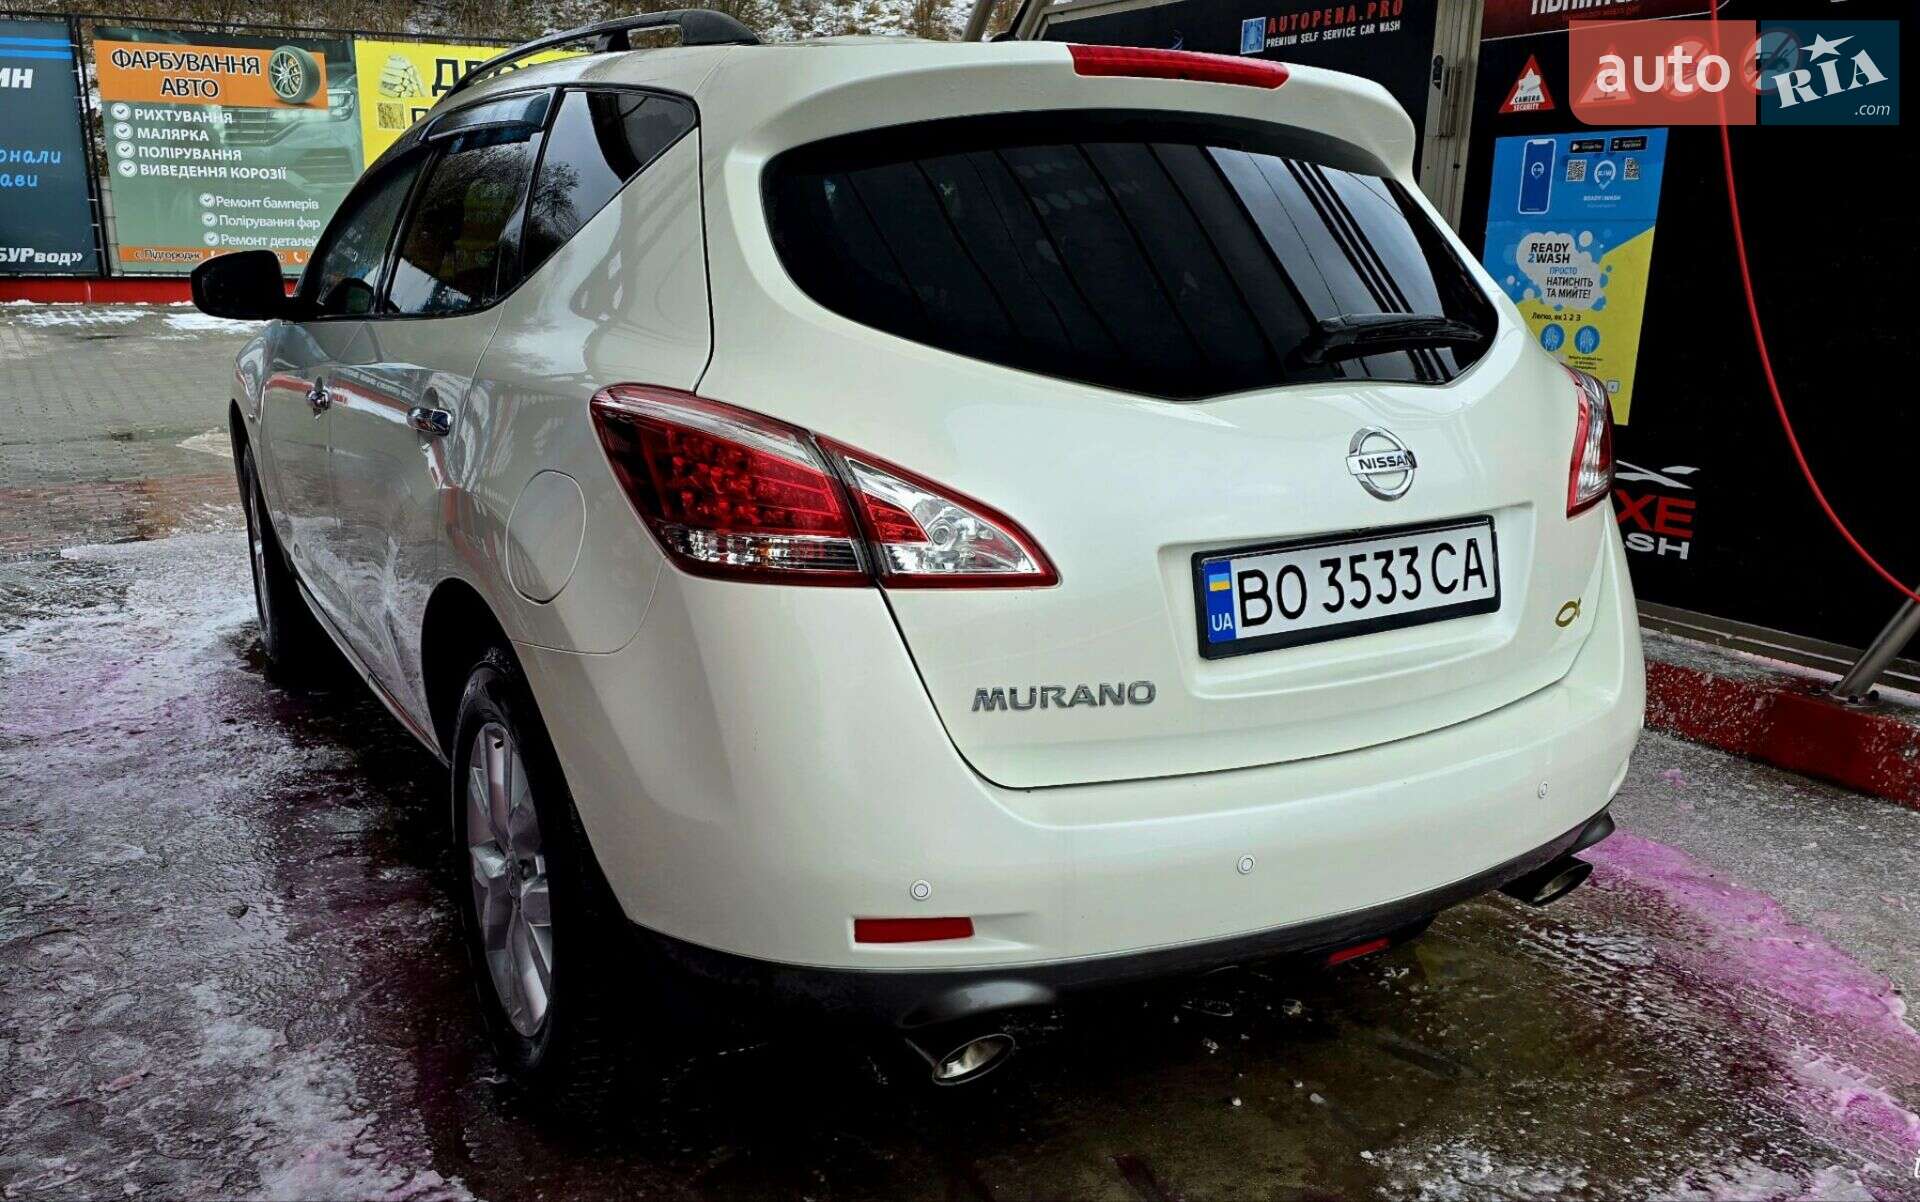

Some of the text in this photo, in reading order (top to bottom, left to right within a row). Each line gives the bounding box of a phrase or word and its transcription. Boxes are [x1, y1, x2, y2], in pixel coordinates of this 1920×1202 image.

[1268, 0, 1403, 34] AUTOPENA.PRO
[1266, 20, 1401, 48] PREMIUM SELF SERVICE CAR WASH
[111, 48, 262, 76] ФАРБУВАННЯ
[160, 77, 220, 99] АВТО
[134, 108, 233, 126] РИХТУВАННЯ
[137, 127, 210, 142] МАЛЯРКА
[138, 146, 242, 161] ПОЛІРУВАННЯ
[140, 164, 287, 181] ВИВЕДЕННЯ КОРОЗІЇ
[216, 195, 320, 211] Ремонт бамперів
[219, 215, 321, 230] Полірування фар
[221, 233, 267, 246] Ремонт
[1531, 243, 1570, 253] READY
[1549, 266, 1578, 275] ПРОСТО
[1546, 277, 1593, 287] НАТИСНІТЬ
[1547, 286, 1592, 299] ТА МИЙТЕ!
[1358, 452, 1415, 470] NISSAN
[1237, 538, 1488, 628] BO 3533 CA
[1211, 612, 1234, 632] UA
[971, 680, 1157, 712] MURANO
